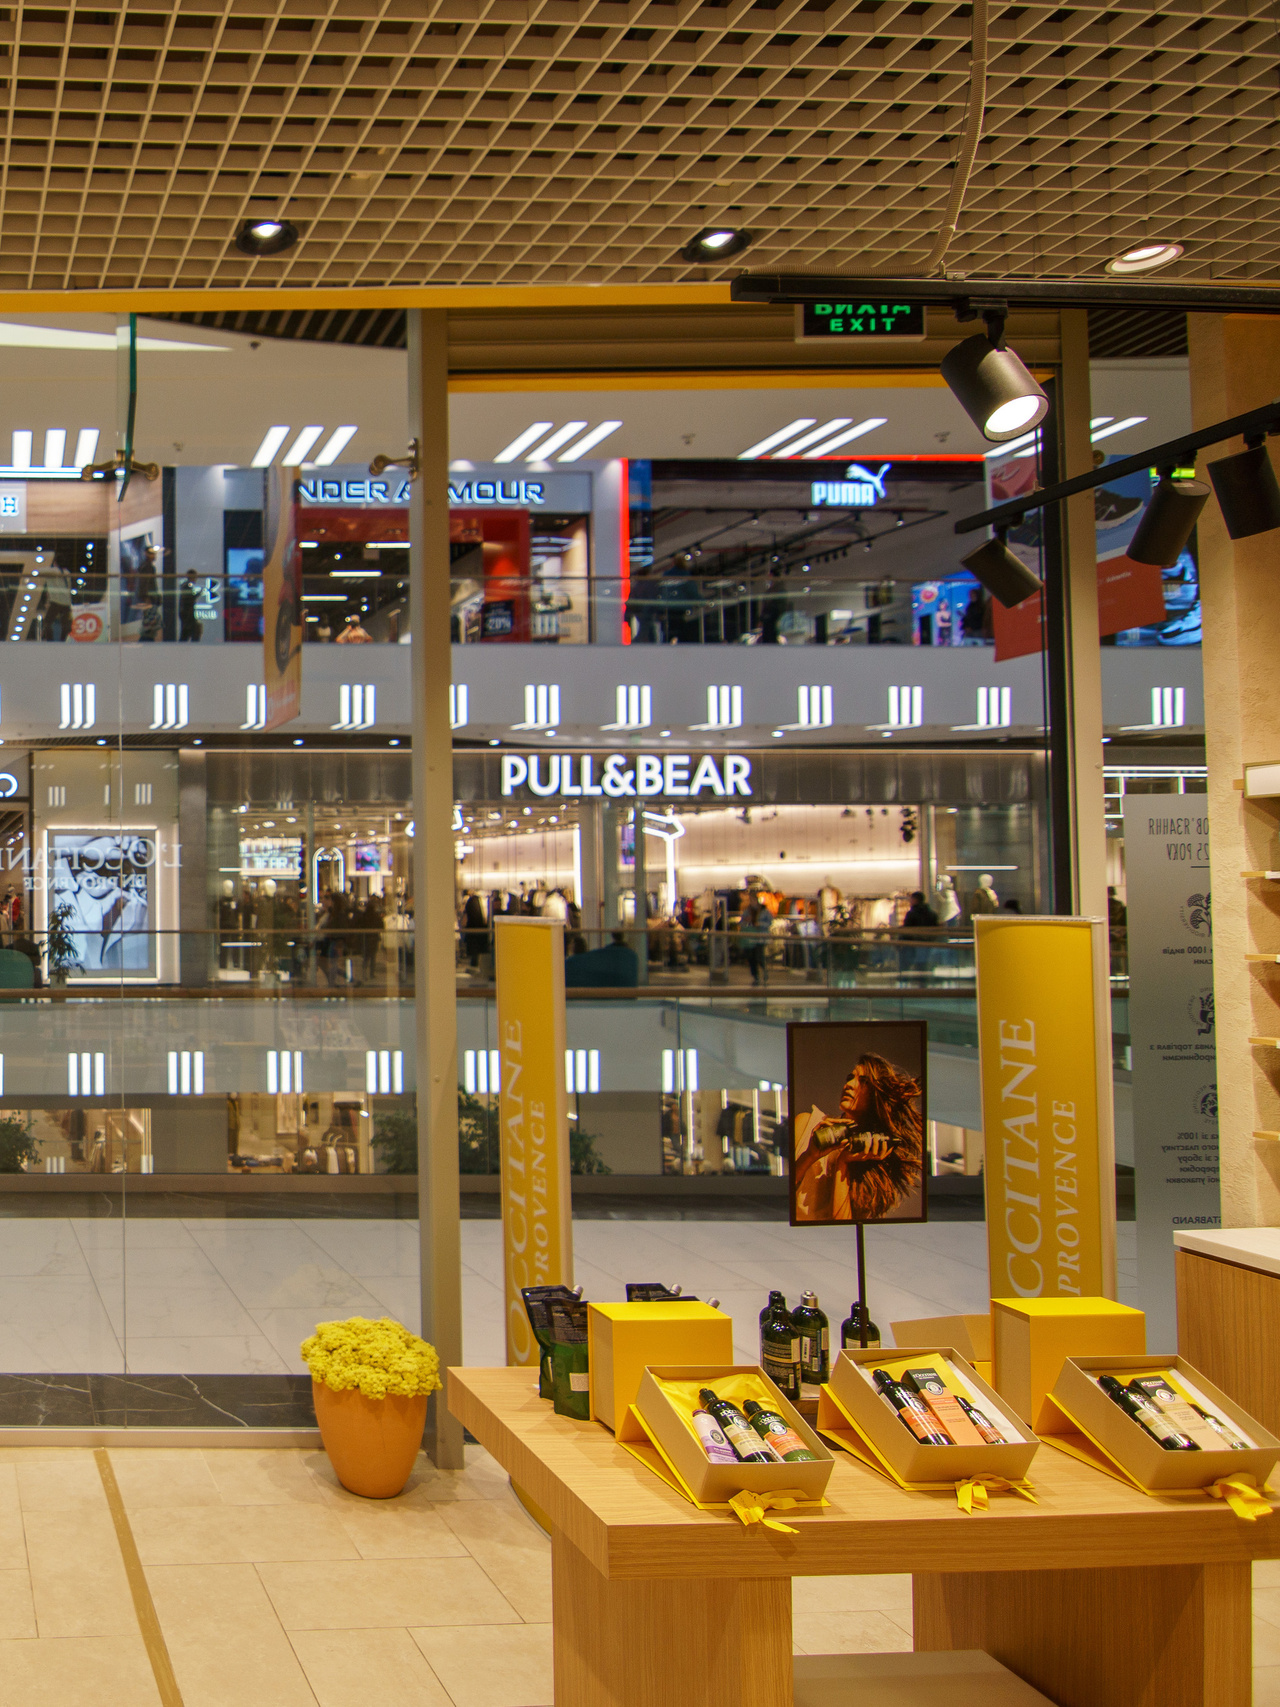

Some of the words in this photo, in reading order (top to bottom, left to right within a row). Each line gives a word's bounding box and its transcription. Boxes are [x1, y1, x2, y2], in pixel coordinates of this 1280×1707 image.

[829, 317, 896, 332] EXIT
[298, 479, 389, 503] NDER
[392, 479, 545, 504] AMOUR
[811, 482, 876, 506] PUMA
[501, 754, 753, 797] PULL&BEAR
[1052, 1100, 1081, 1297] PROVENCE
